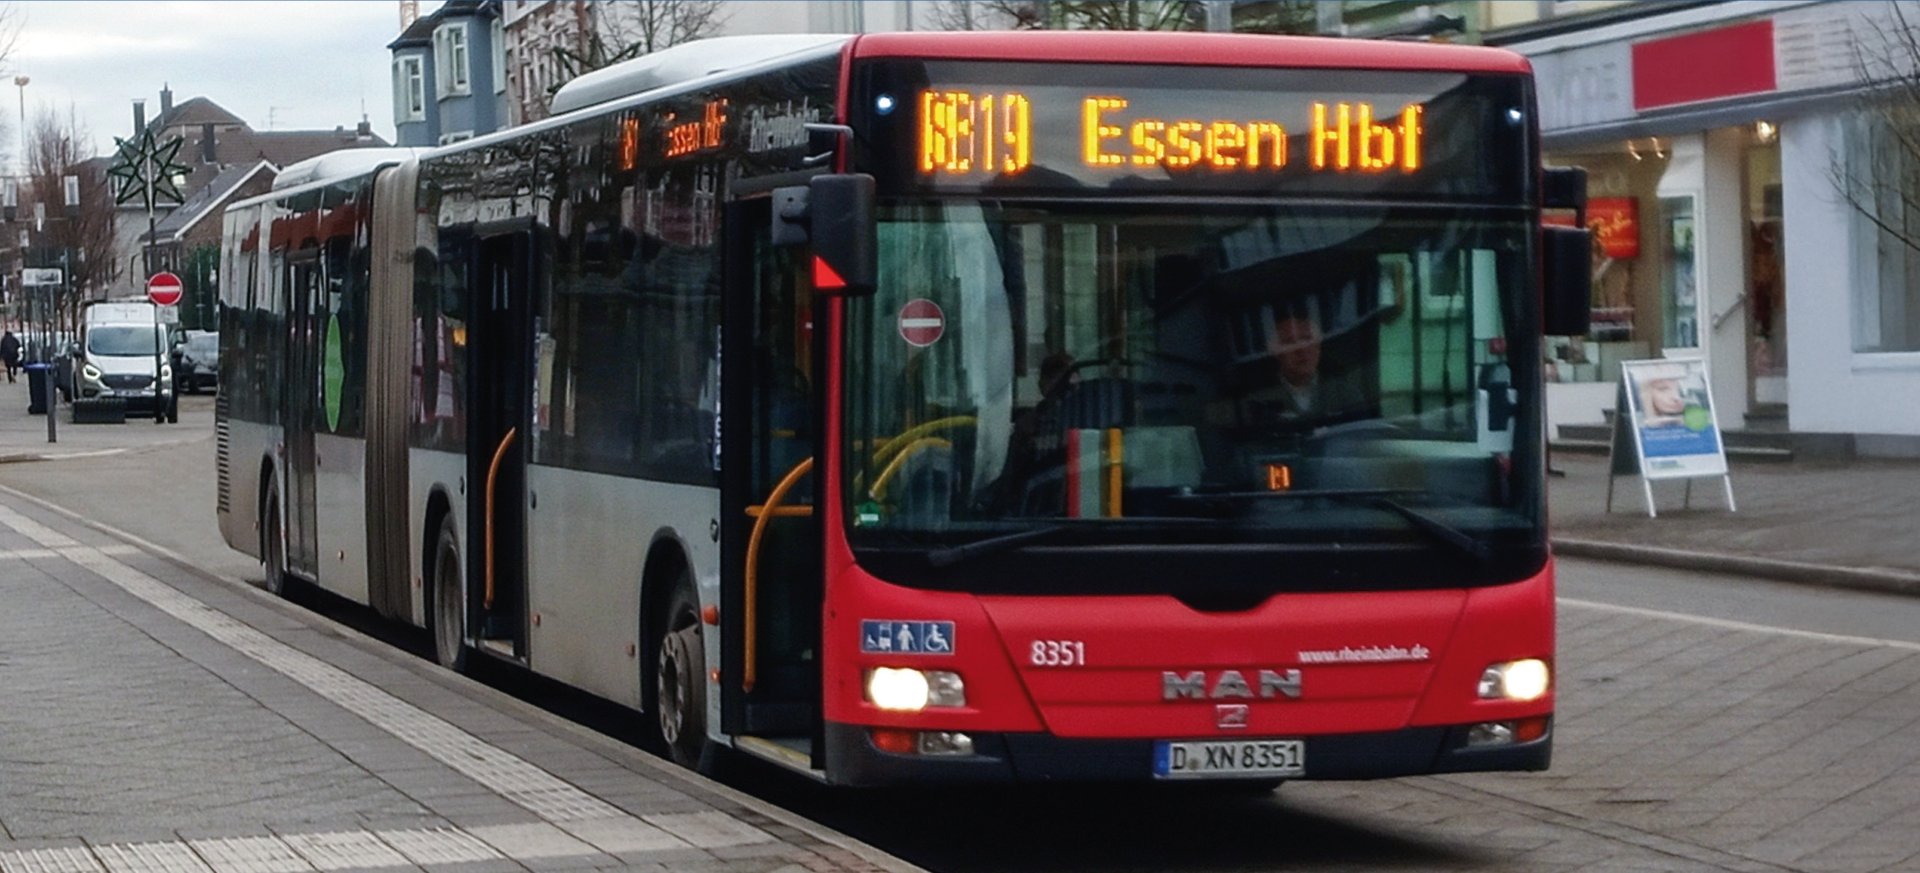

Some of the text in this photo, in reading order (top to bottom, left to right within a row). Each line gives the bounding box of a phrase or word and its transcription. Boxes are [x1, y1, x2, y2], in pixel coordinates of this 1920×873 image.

[1084, 97, 1288, 168] Essen
[1314, 102, 1423, 170] Hbf
[1032, 640, 1084, 666] 8351
[1299, 643, 1429, 663] www.rheinbahn.de
[1162, 669, 1302, 699] MAN
[1172, 744, 1300, 770] D XN 8351
